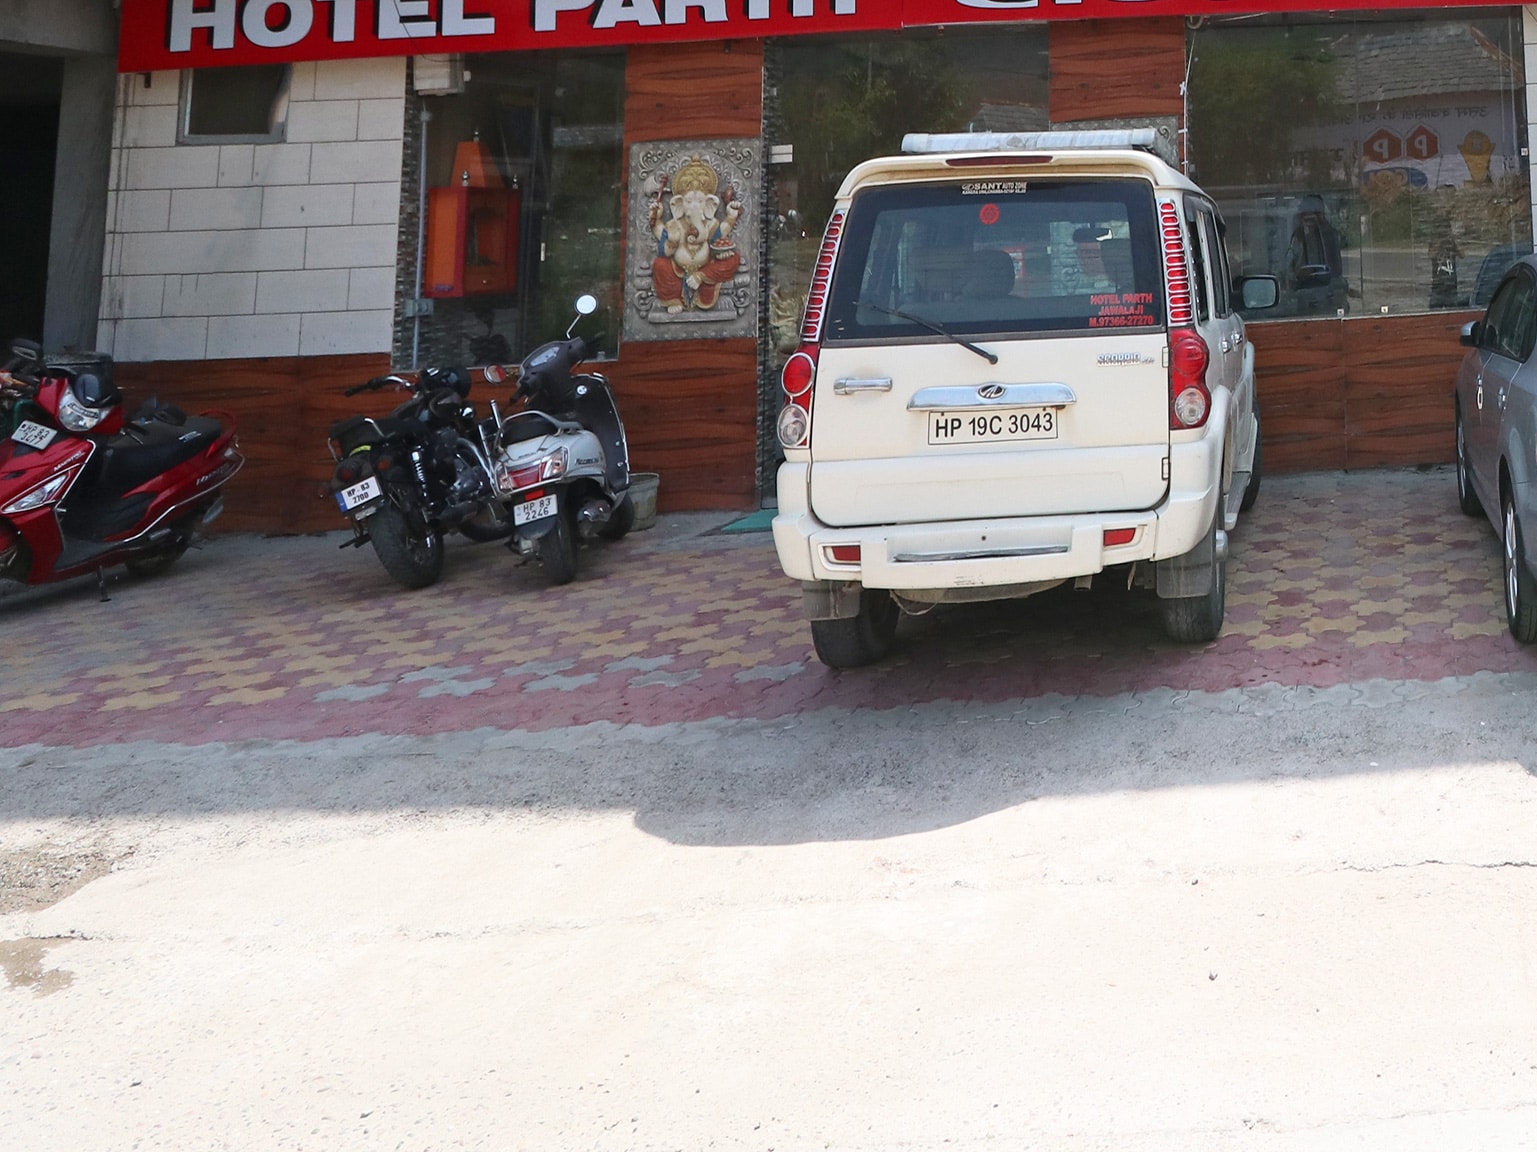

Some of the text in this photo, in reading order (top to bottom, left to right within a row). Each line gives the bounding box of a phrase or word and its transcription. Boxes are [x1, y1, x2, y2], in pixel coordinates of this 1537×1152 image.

[974, 182, 1003, 190] SANT
[1090, 293, 1153, 305] HOTEL PARTH
[935, 412, 1053, 438] HP 19C 3043
[523, 497, 552, 513] HP 83
